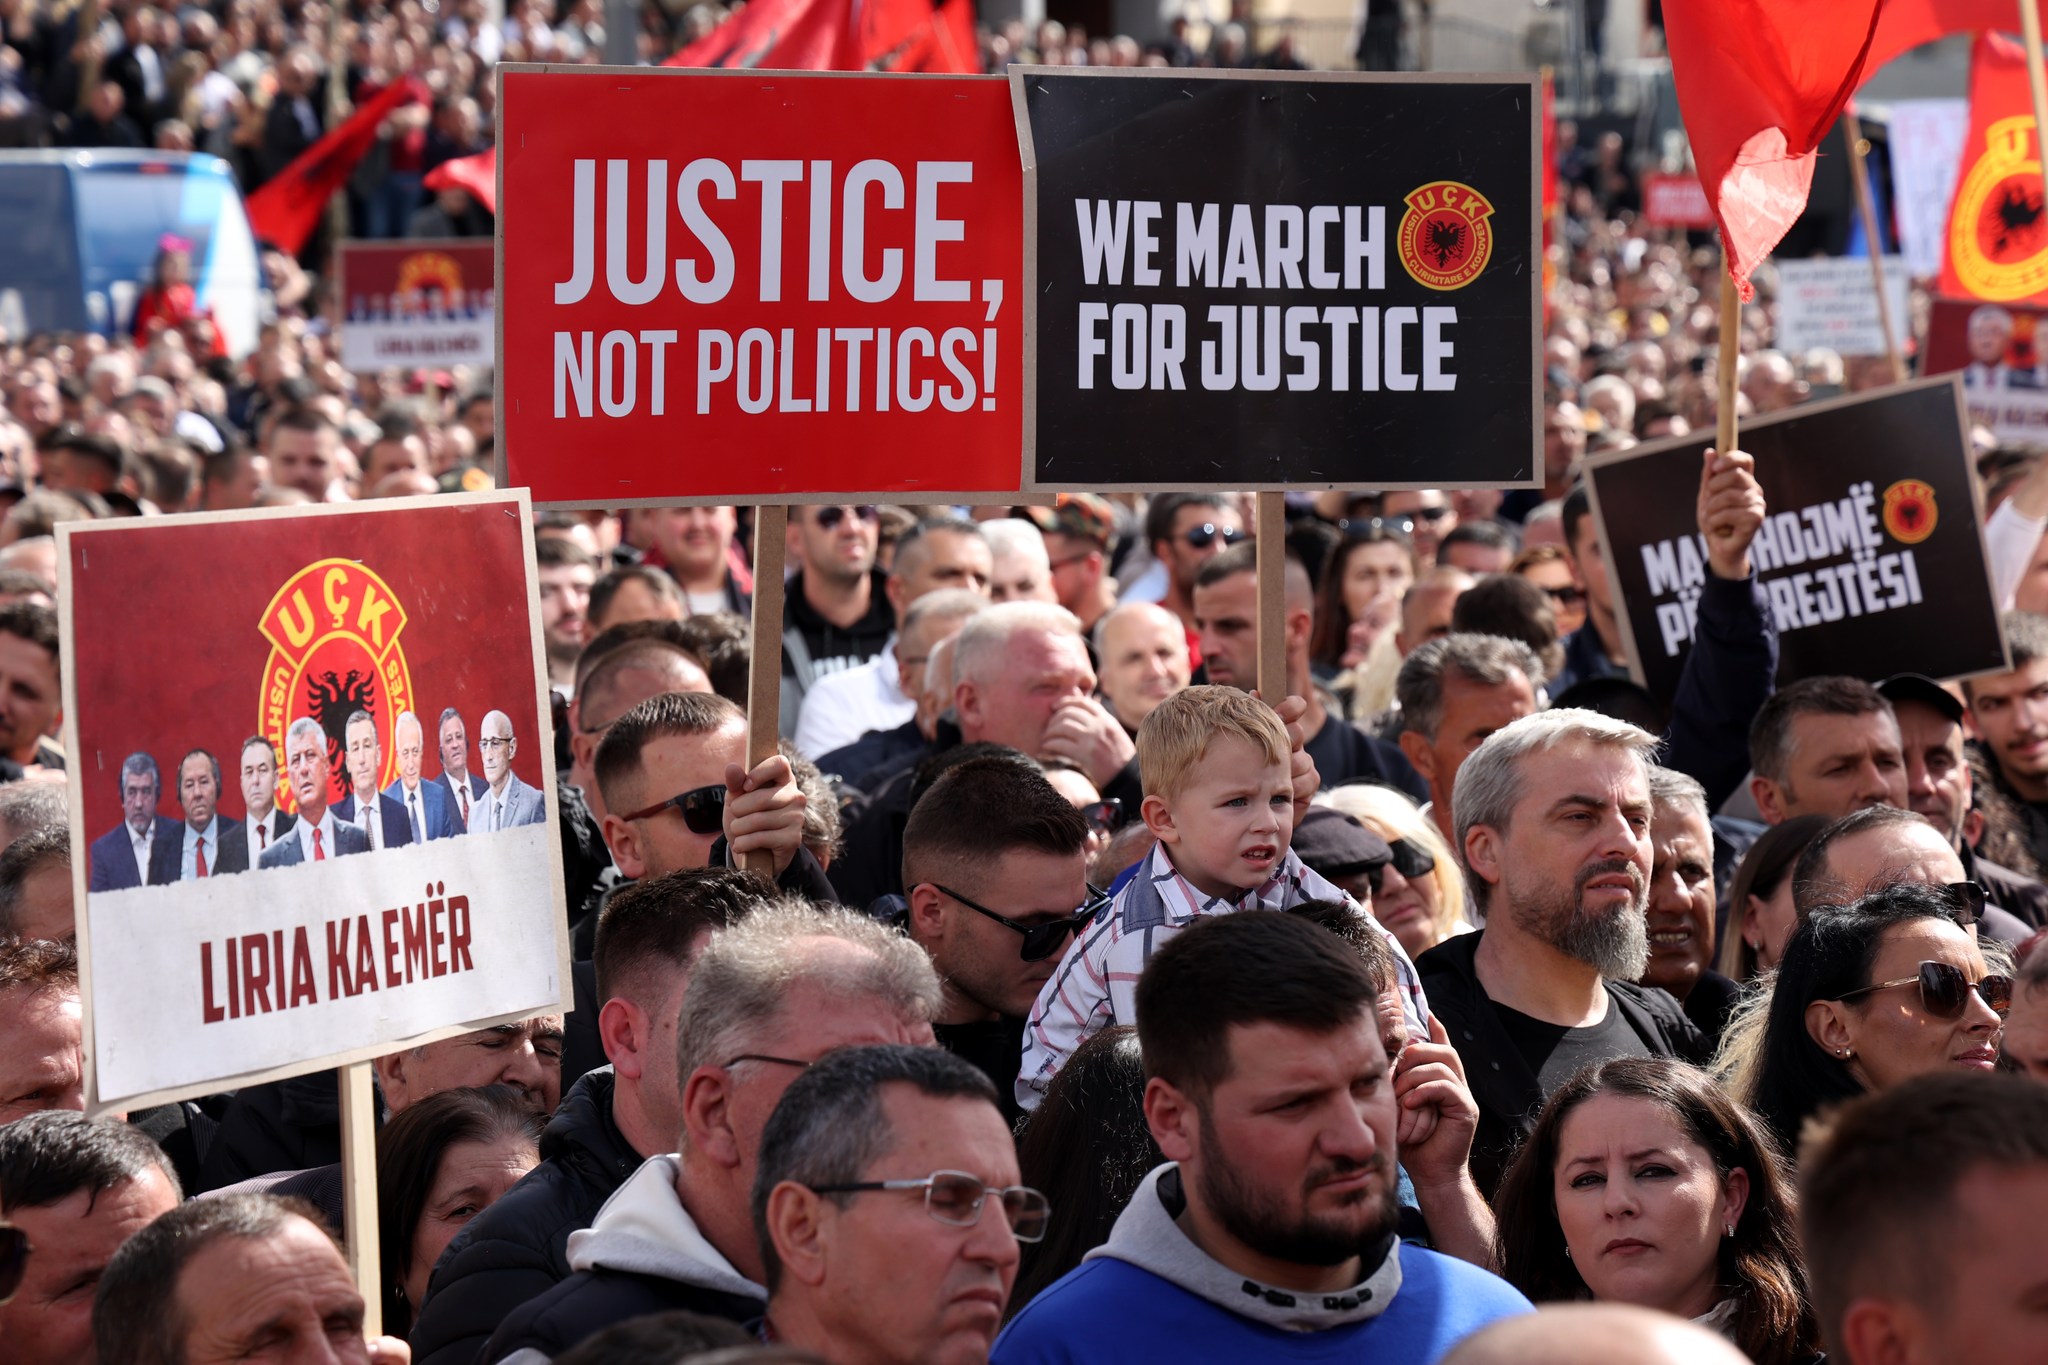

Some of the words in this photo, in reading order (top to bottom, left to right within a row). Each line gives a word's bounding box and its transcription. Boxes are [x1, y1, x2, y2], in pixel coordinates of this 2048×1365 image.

[555, 158, 1003, 322] JUSTICE,
[1075, 198, 1163, 287] WE
[1176, 202, 1386, 290] MARCH
[1404, 214, 1420, 259] USHTRIA
[1463, 268, 1472, 280] E
[1416, 186, 1483, 220] UÇK
[554, 329, 677, 418] NOT
[697, 327, 997, 414] POLITICS!
[1078, 302, 1186, 390] FOR
[1201, 305, 1458, 391] JUSTICE
[1640, 480, 1884, 597] MAHOJMË
[277, 567, 392, 649] UÇK
[1754, 548, 1923, 632] REJTËSI
[201, 926, 318, 1025] LIRIA
[326, 914, 379, 1001] KA
[382, 880, 474, 989] EMËR
